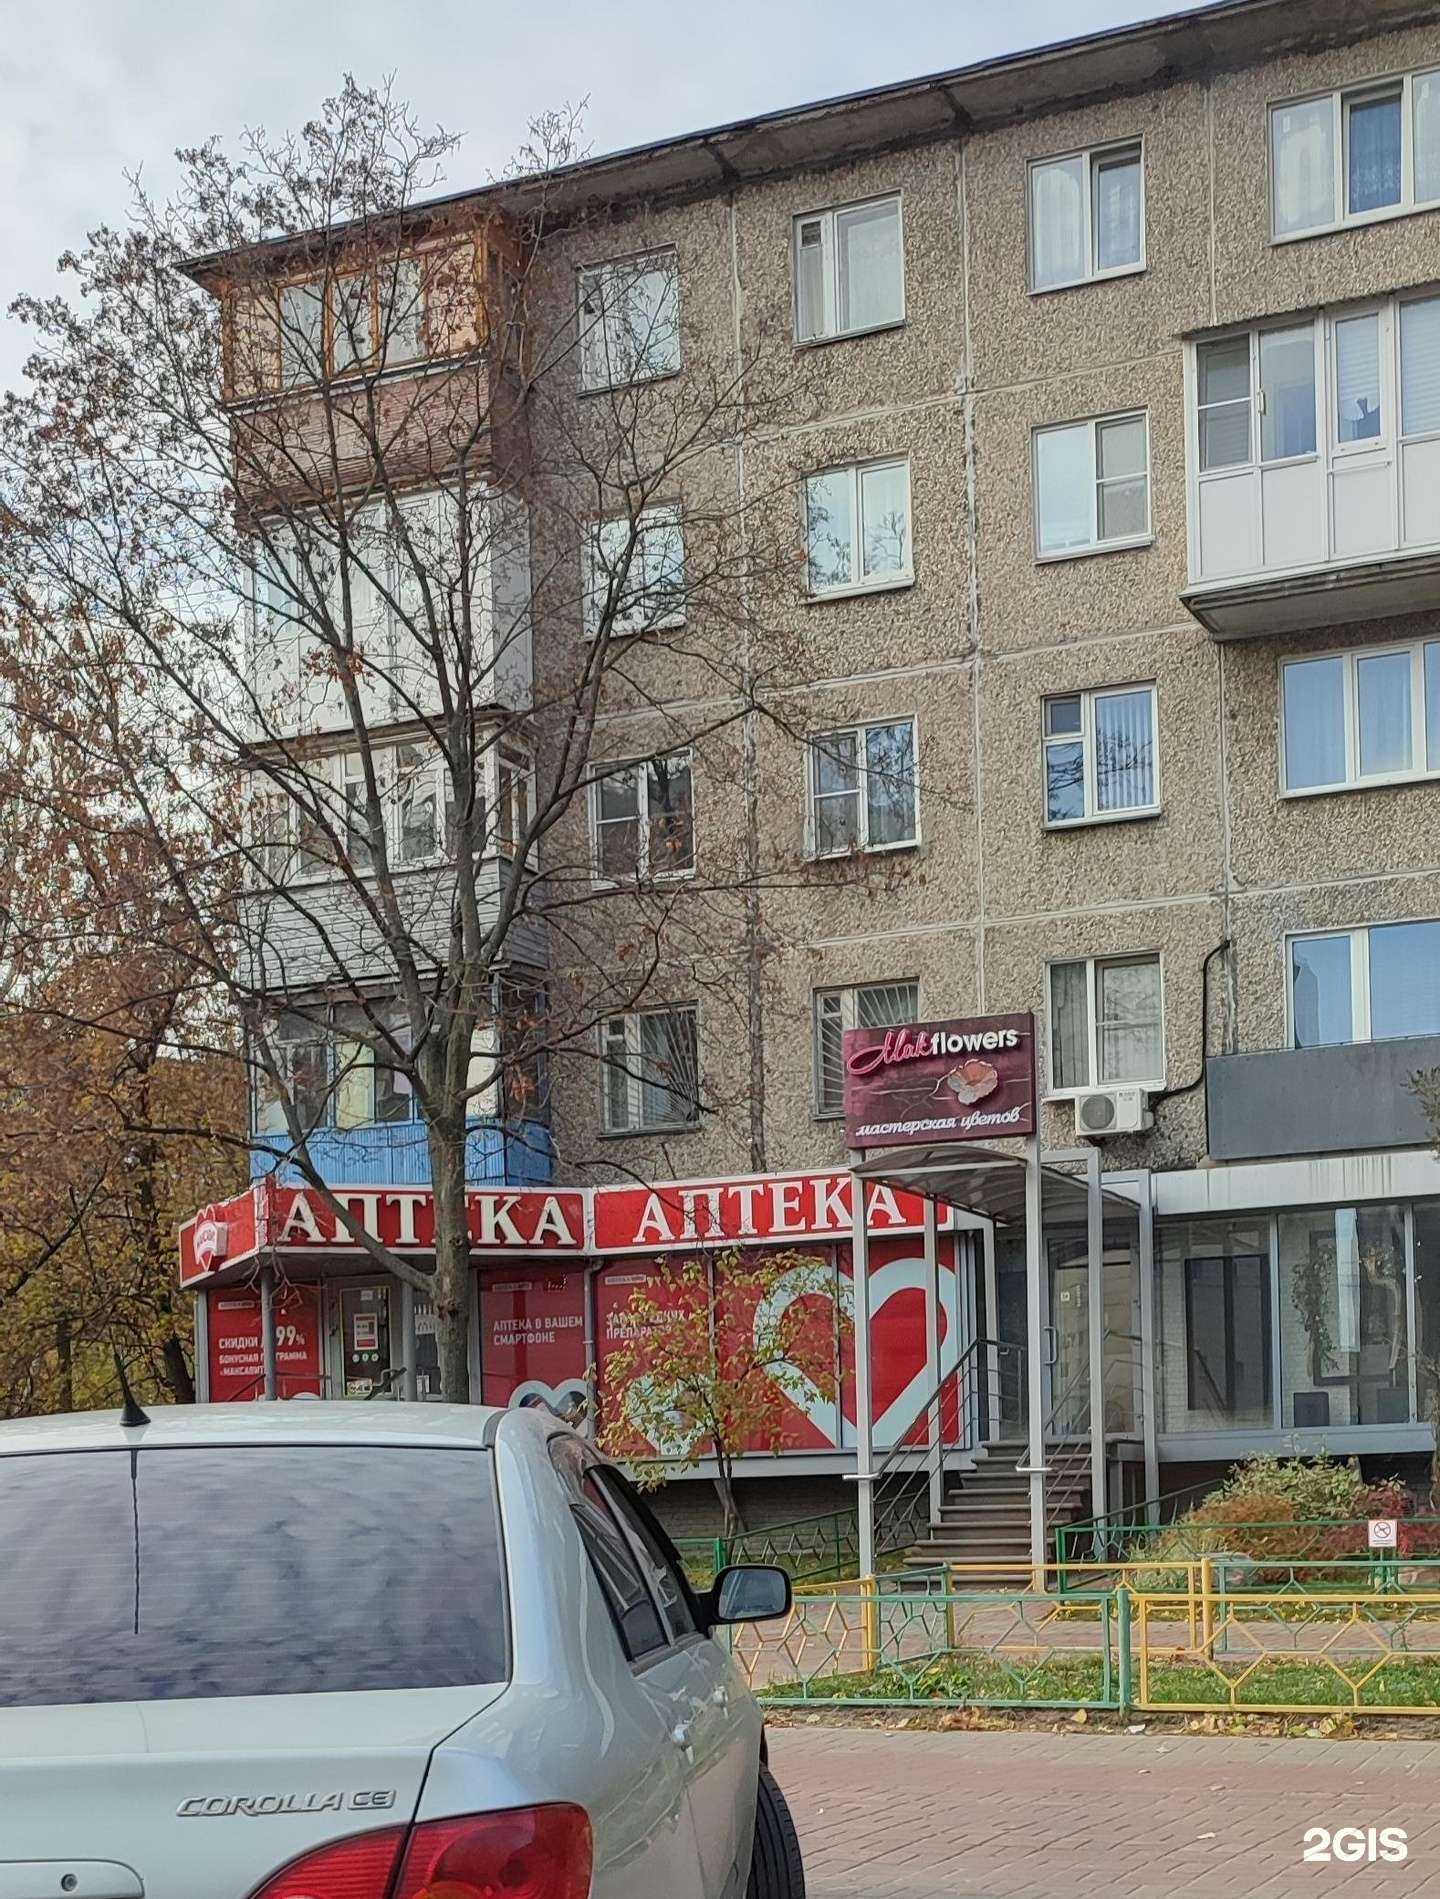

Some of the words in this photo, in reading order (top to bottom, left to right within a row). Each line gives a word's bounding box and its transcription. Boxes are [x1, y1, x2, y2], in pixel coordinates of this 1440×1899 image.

[855, 1117, 957, 1136] мастерская
[960, 1107, 1021, 1132] цветов
[276, 1192, 578, 1246] АПТКА
[632, 1177, 907, 1243] АПТЕКА
[493, 1318, 533, 1332] АПТЕКА
[544, 1315, 584, 1329] ВАШЕМ
[219, 1336, 258, 1350] СКИДКИ
[275, 1325, 305, 1347] 99%
[494, 1331, 556, 1346] СМАРТФОНЕ
[176, 1791, 344, 1817] COROLLA
